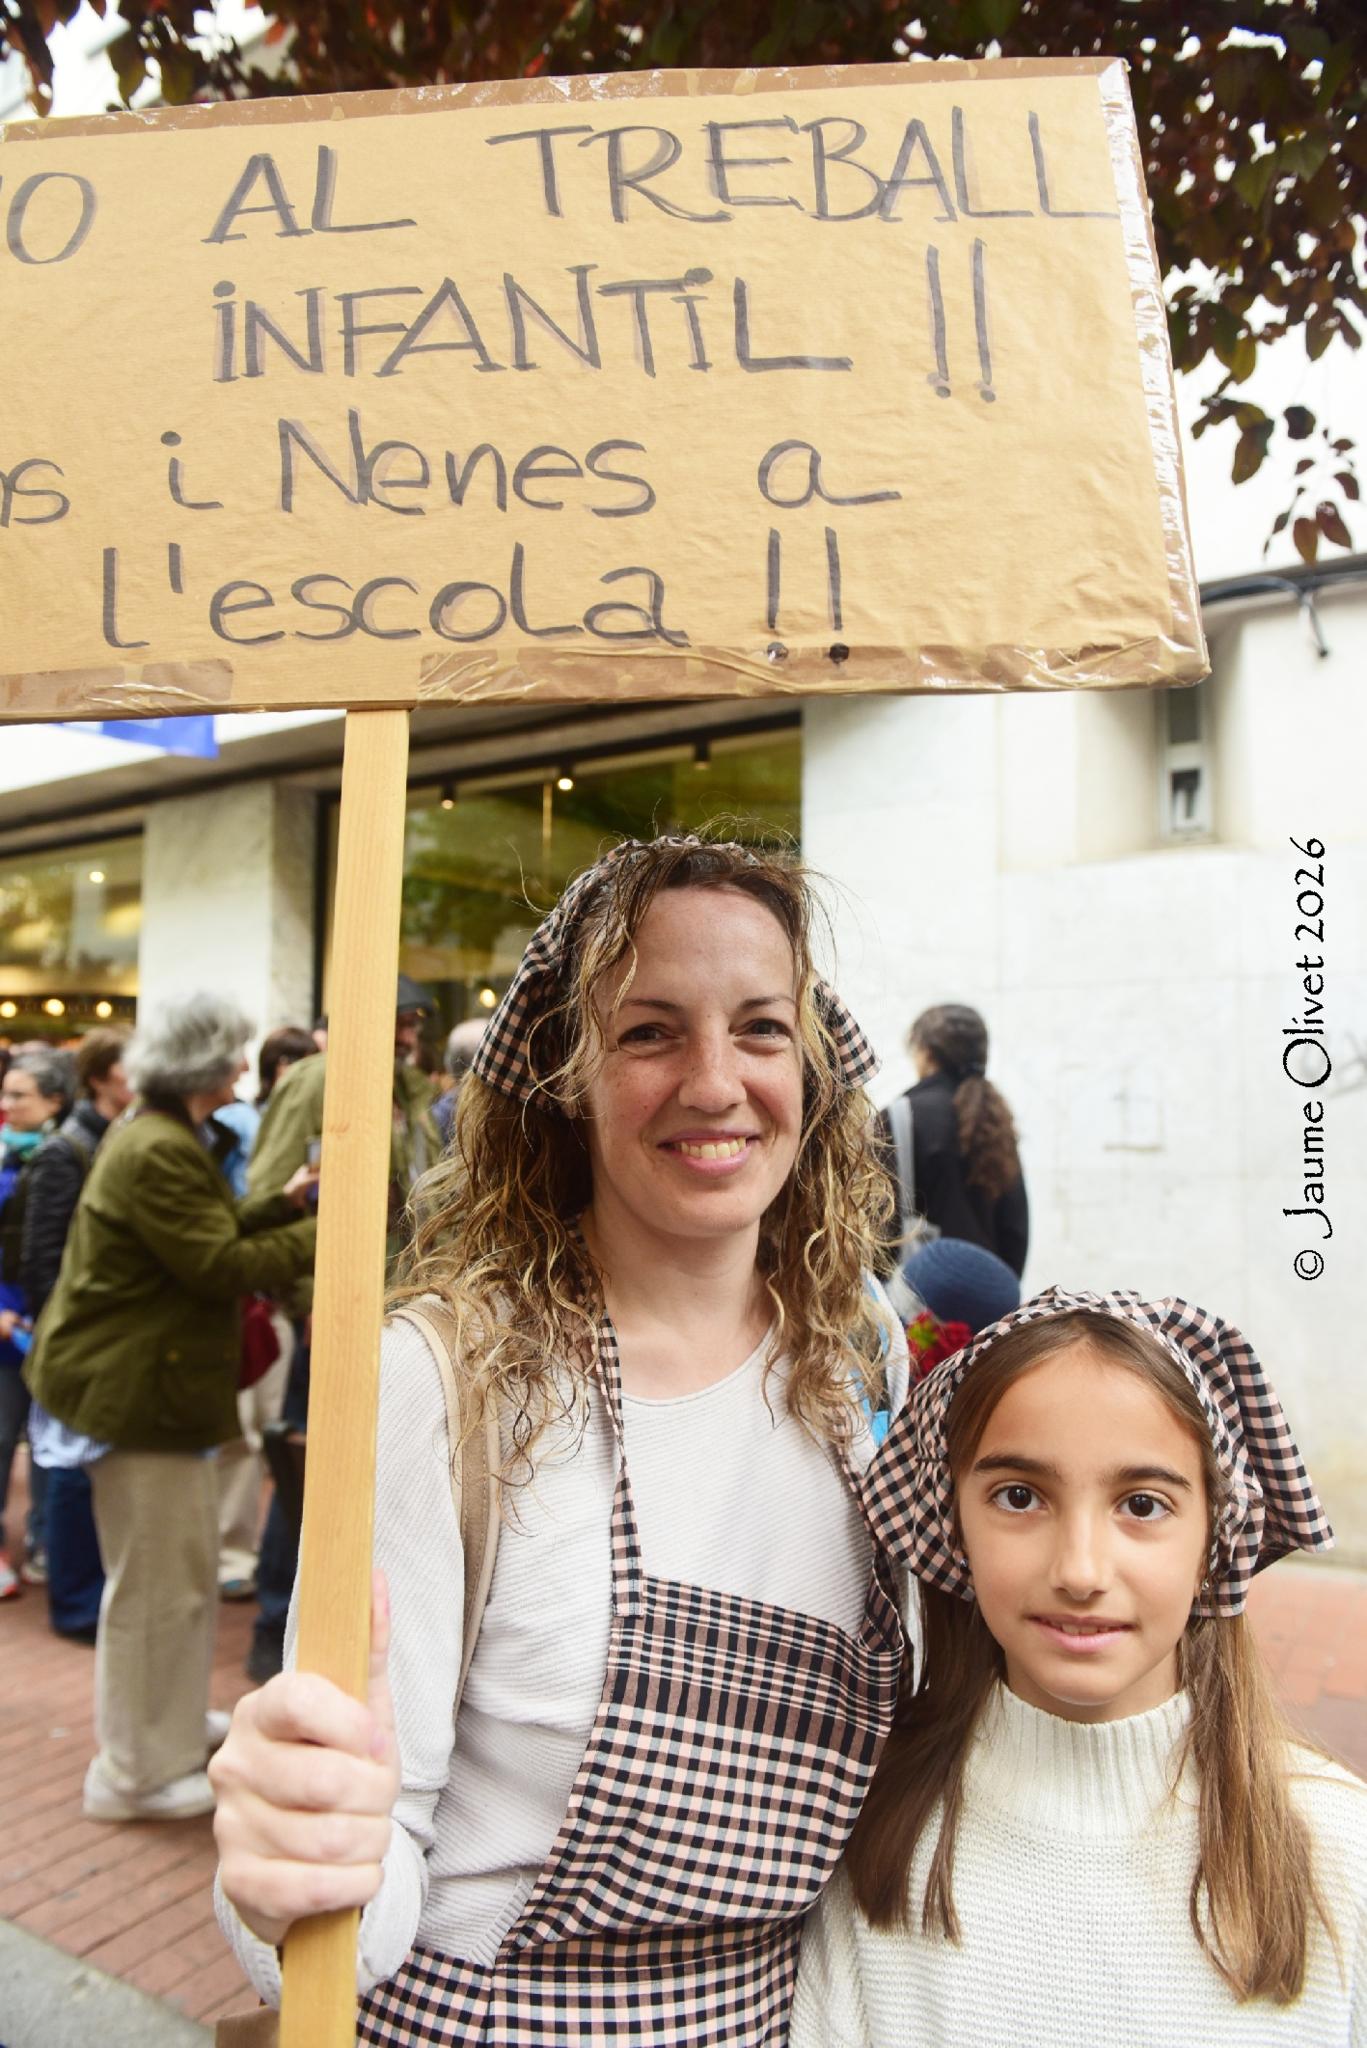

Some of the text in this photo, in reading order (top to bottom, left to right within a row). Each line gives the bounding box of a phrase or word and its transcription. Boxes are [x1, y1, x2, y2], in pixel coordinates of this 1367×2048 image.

[0, 106, 1120, 264] O AL TREBALL
[927, 237, 996, 403] !!
[160, 431, 224, 512] i
[278, 408, 657, 517] Nenes
[757, 439, 902, 509] a
[766, 526, 850, 664] !!
